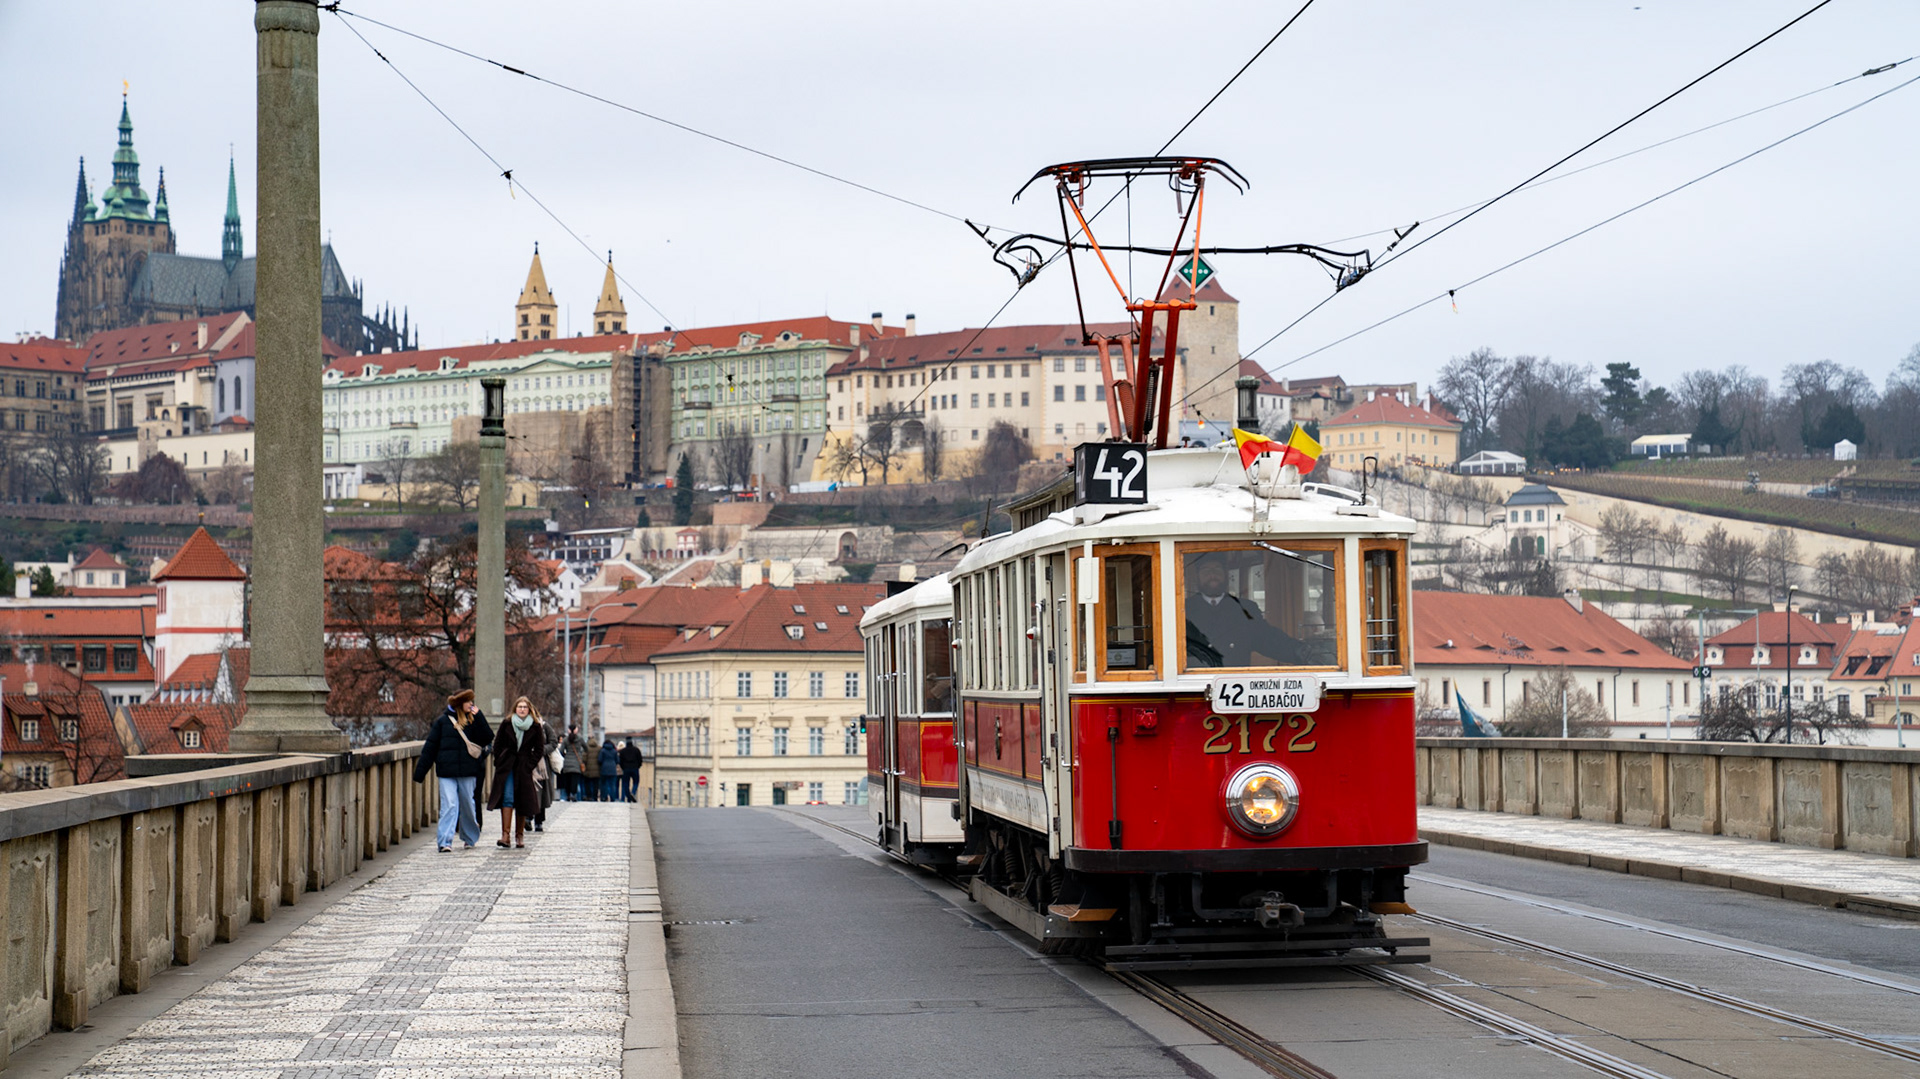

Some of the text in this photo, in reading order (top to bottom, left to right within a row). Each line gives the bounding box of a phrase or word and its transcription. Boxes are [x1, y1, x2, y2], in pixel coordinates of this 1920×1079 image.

[1093, 449, 1144, 498] 42
[1219, 683, 1244, 706] 42
[1250, 679, 1303, 690] OKRUŽNÍ JÍZDA
[1248, 692, 1304, 708] DLABAČOV
[1203, 713, 1317, 754] 2172
